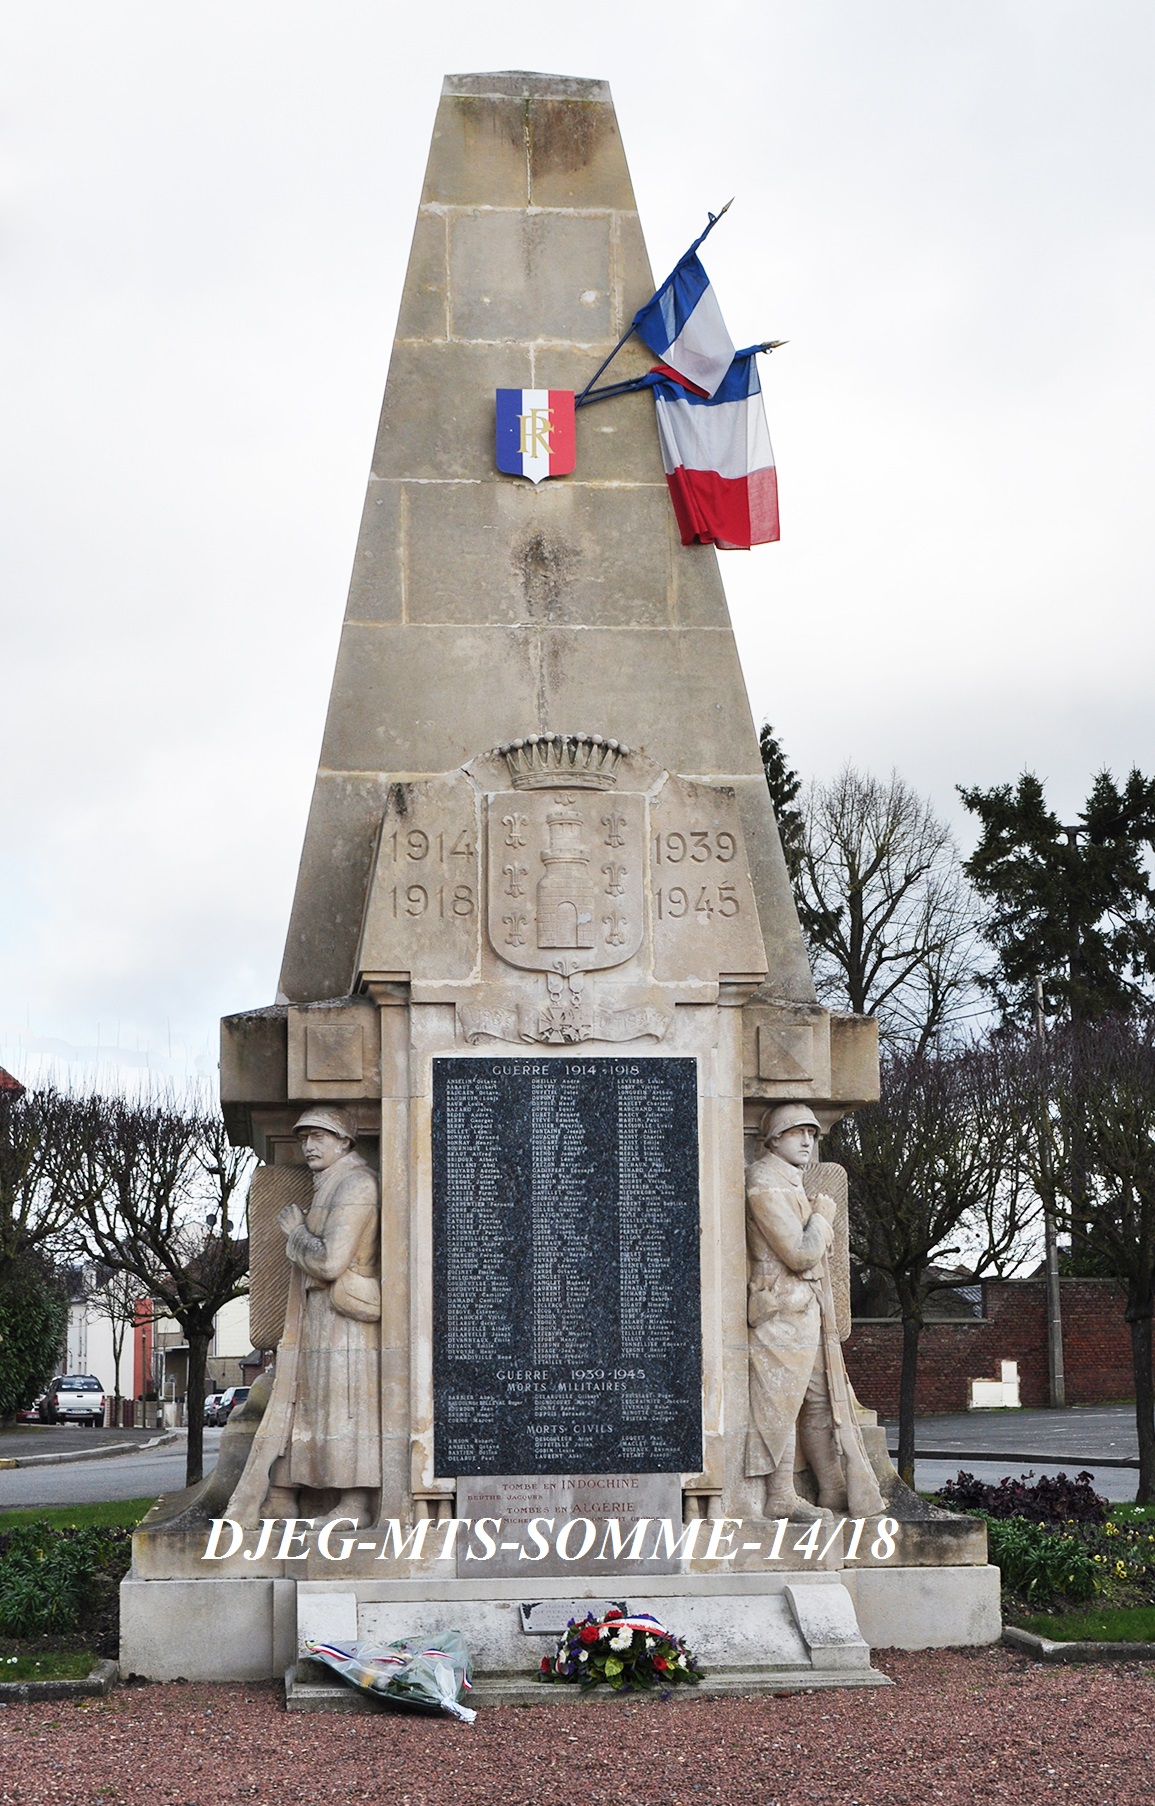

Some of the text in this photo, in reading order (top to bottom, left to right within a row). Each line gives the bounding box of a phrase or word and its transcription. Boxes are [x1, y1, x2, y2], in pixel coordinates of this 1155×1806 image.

[389, 829, 475, 863] 1914
[654, 831, 737, 865] 1939
[389, 884, 475, 918] 1918
[654, 881, 741, 920] 1945
[492, 1065, 549, 1075] GUERRE
[496, 1370, 549, 1380] GUERRE
[506, 1382, 627, 1391] MORTS MILITAIRES
[526, 1424, 613, 1434] MORTS CIVILS
[562, 1479, 639, 1490] INDOCHINE
[572, 1501, 635, 1512] ALGÉRIE
